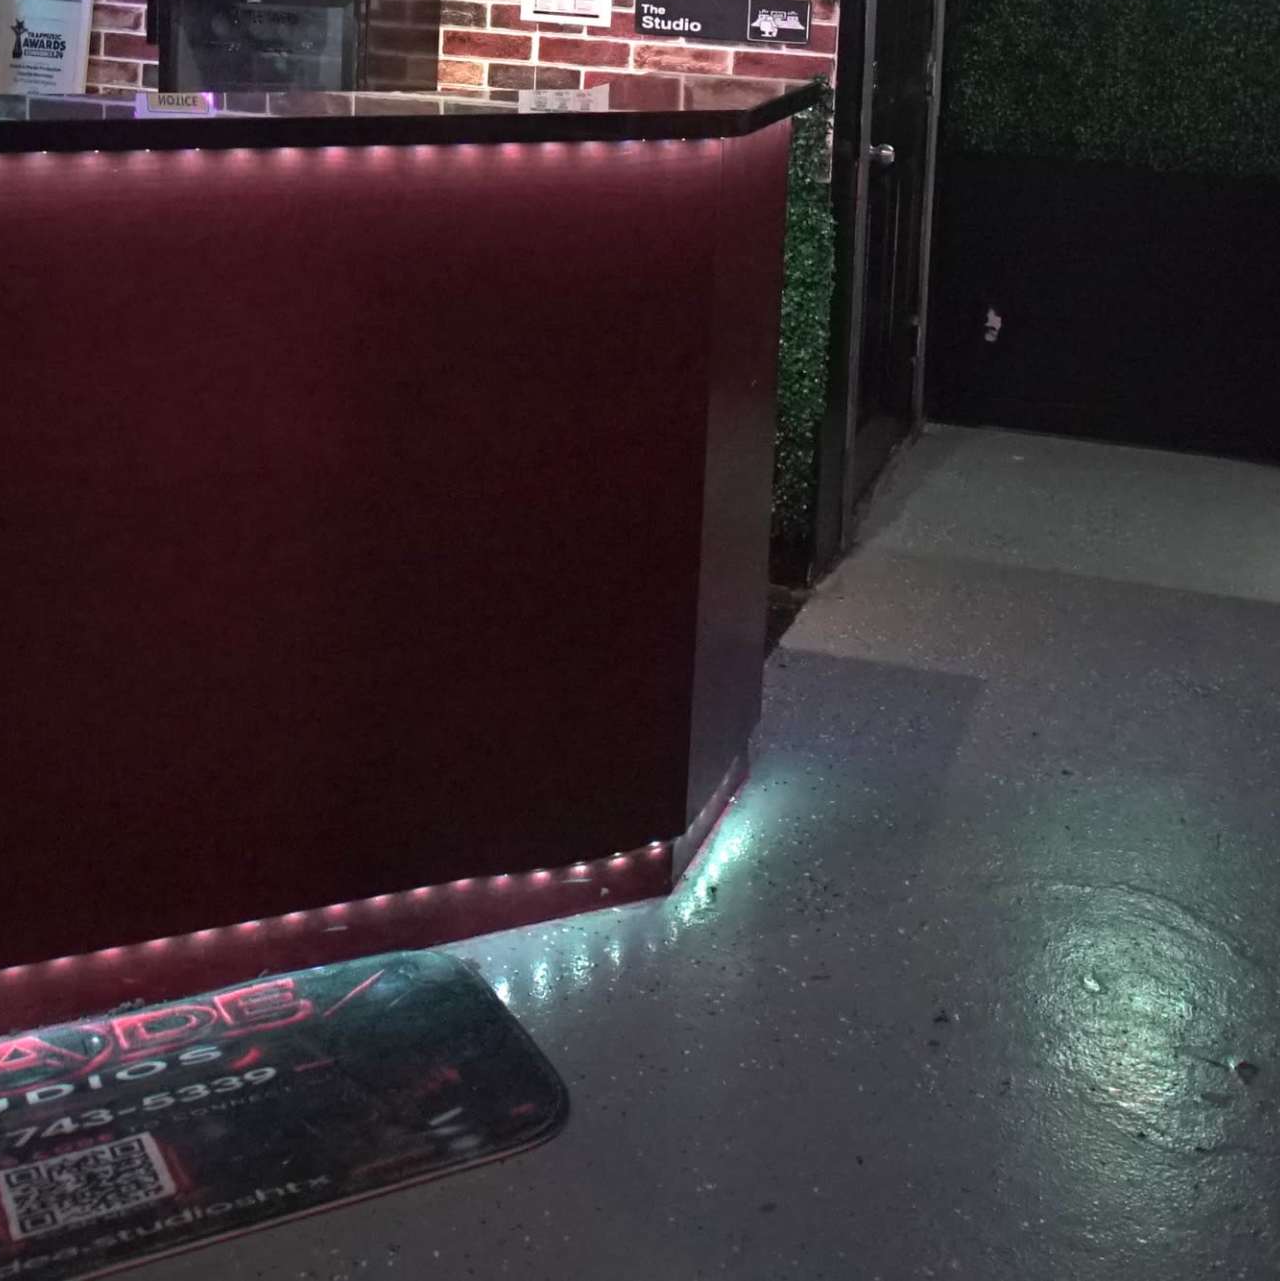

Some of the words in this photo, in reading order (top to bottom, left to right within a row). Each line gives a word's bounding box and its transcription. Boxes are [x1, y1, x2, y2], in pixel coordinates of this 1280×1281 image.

[641, 3, 666, 15] The
[641, 15, 702, 33] Studio
[23, 38, 67, 52] AWARDS
[4, 1066, 278, 1148] 743-5339
